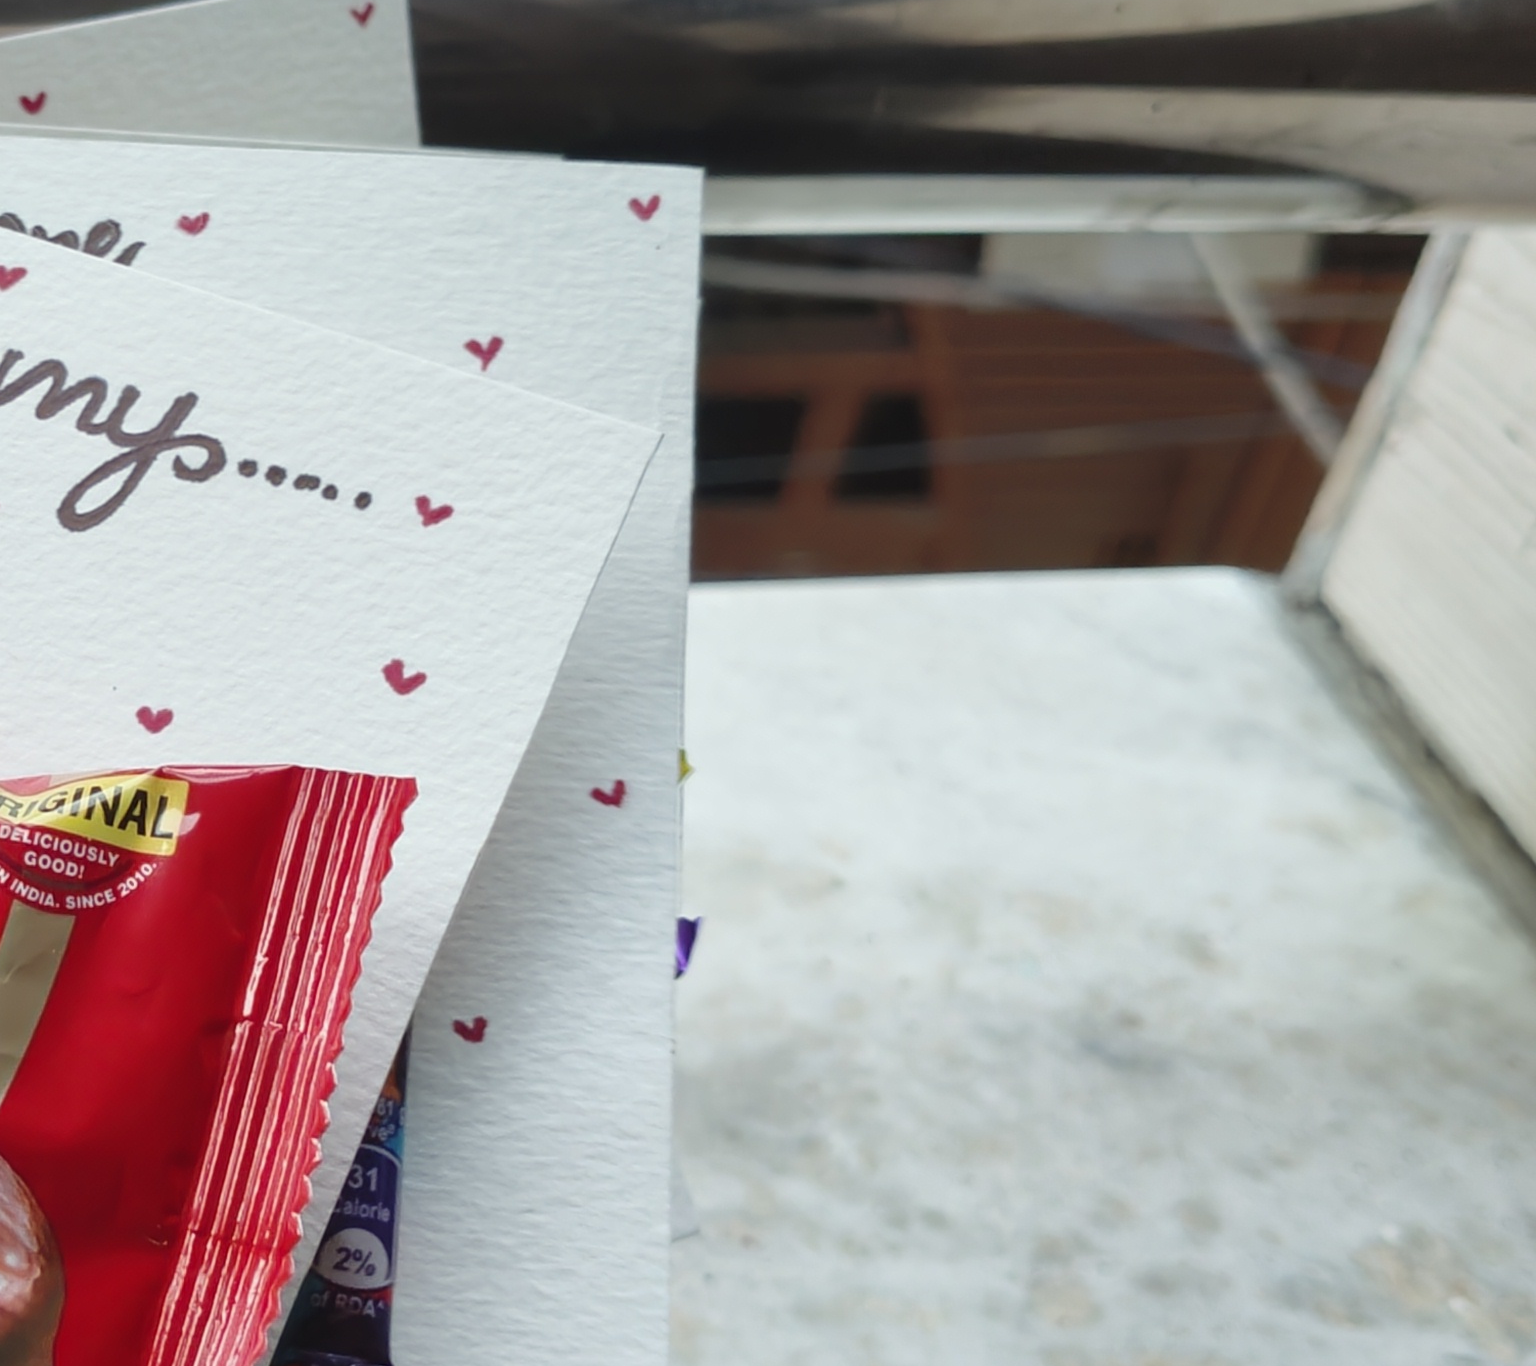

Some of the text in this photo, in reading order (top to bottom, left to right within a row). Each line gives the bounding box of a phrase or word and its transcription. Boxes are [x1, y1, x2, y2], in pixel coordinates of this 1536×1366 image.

[23, 850, 86, 880] GOOD!
[65, 889, 117, 910] SINCE
[332, 1245, 377, 1277] 2%
[309, 1290, 331, 1309] of
